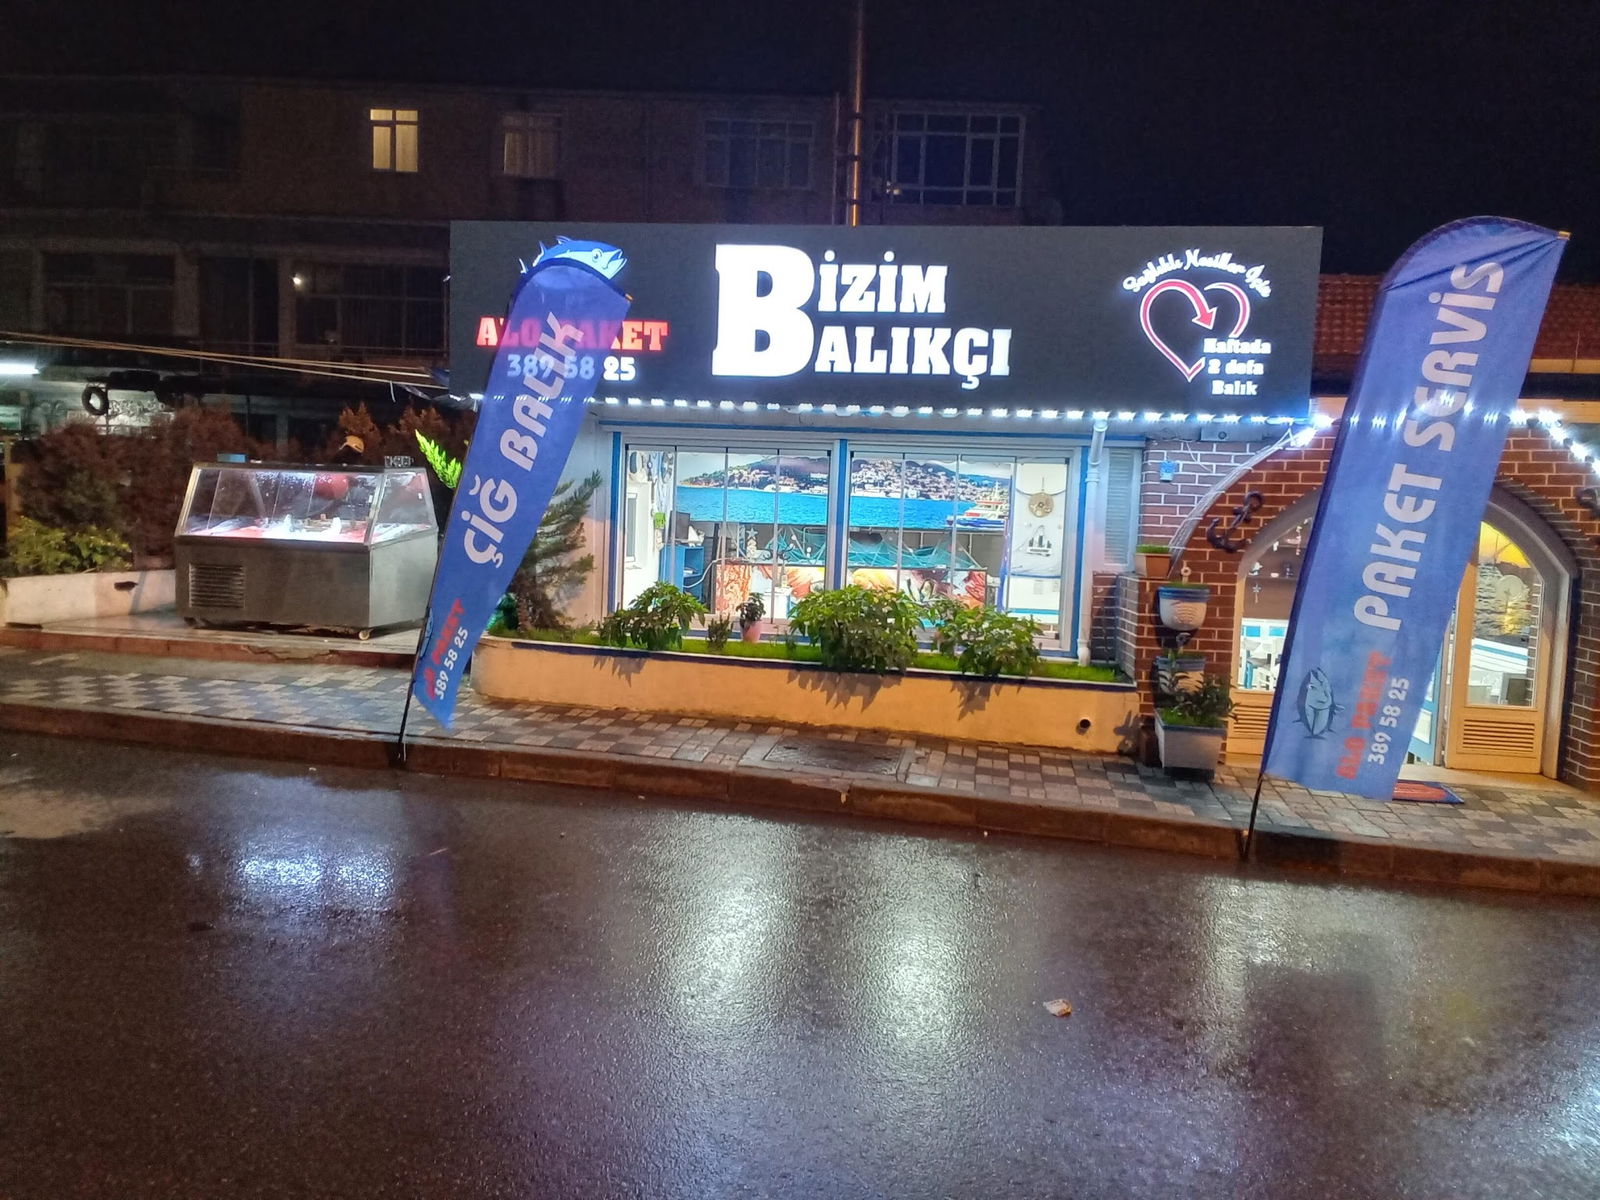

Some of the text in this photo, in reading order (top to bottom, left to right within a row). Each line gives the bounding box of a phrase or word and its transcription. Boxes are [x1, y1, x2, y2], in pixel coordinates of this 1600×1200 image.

[475, 317, 542, 348] ALO
[1203, 337, 1272, 354] Haftada
[506, 353, 637, 381] 389 58 25
[1207, 358, 1265, 375] 2 defa
[1211, 379, 1259, 396] Balık
[460, 311, 585, 569] ÇİĞ BALIK
[1354, 260, 1506, 633] PAKET SERVİS
[443, 648, 459, 671] 58
[454, 626, 469, 649] 25
[1367, 677, 1410, 765] 389 58 25
